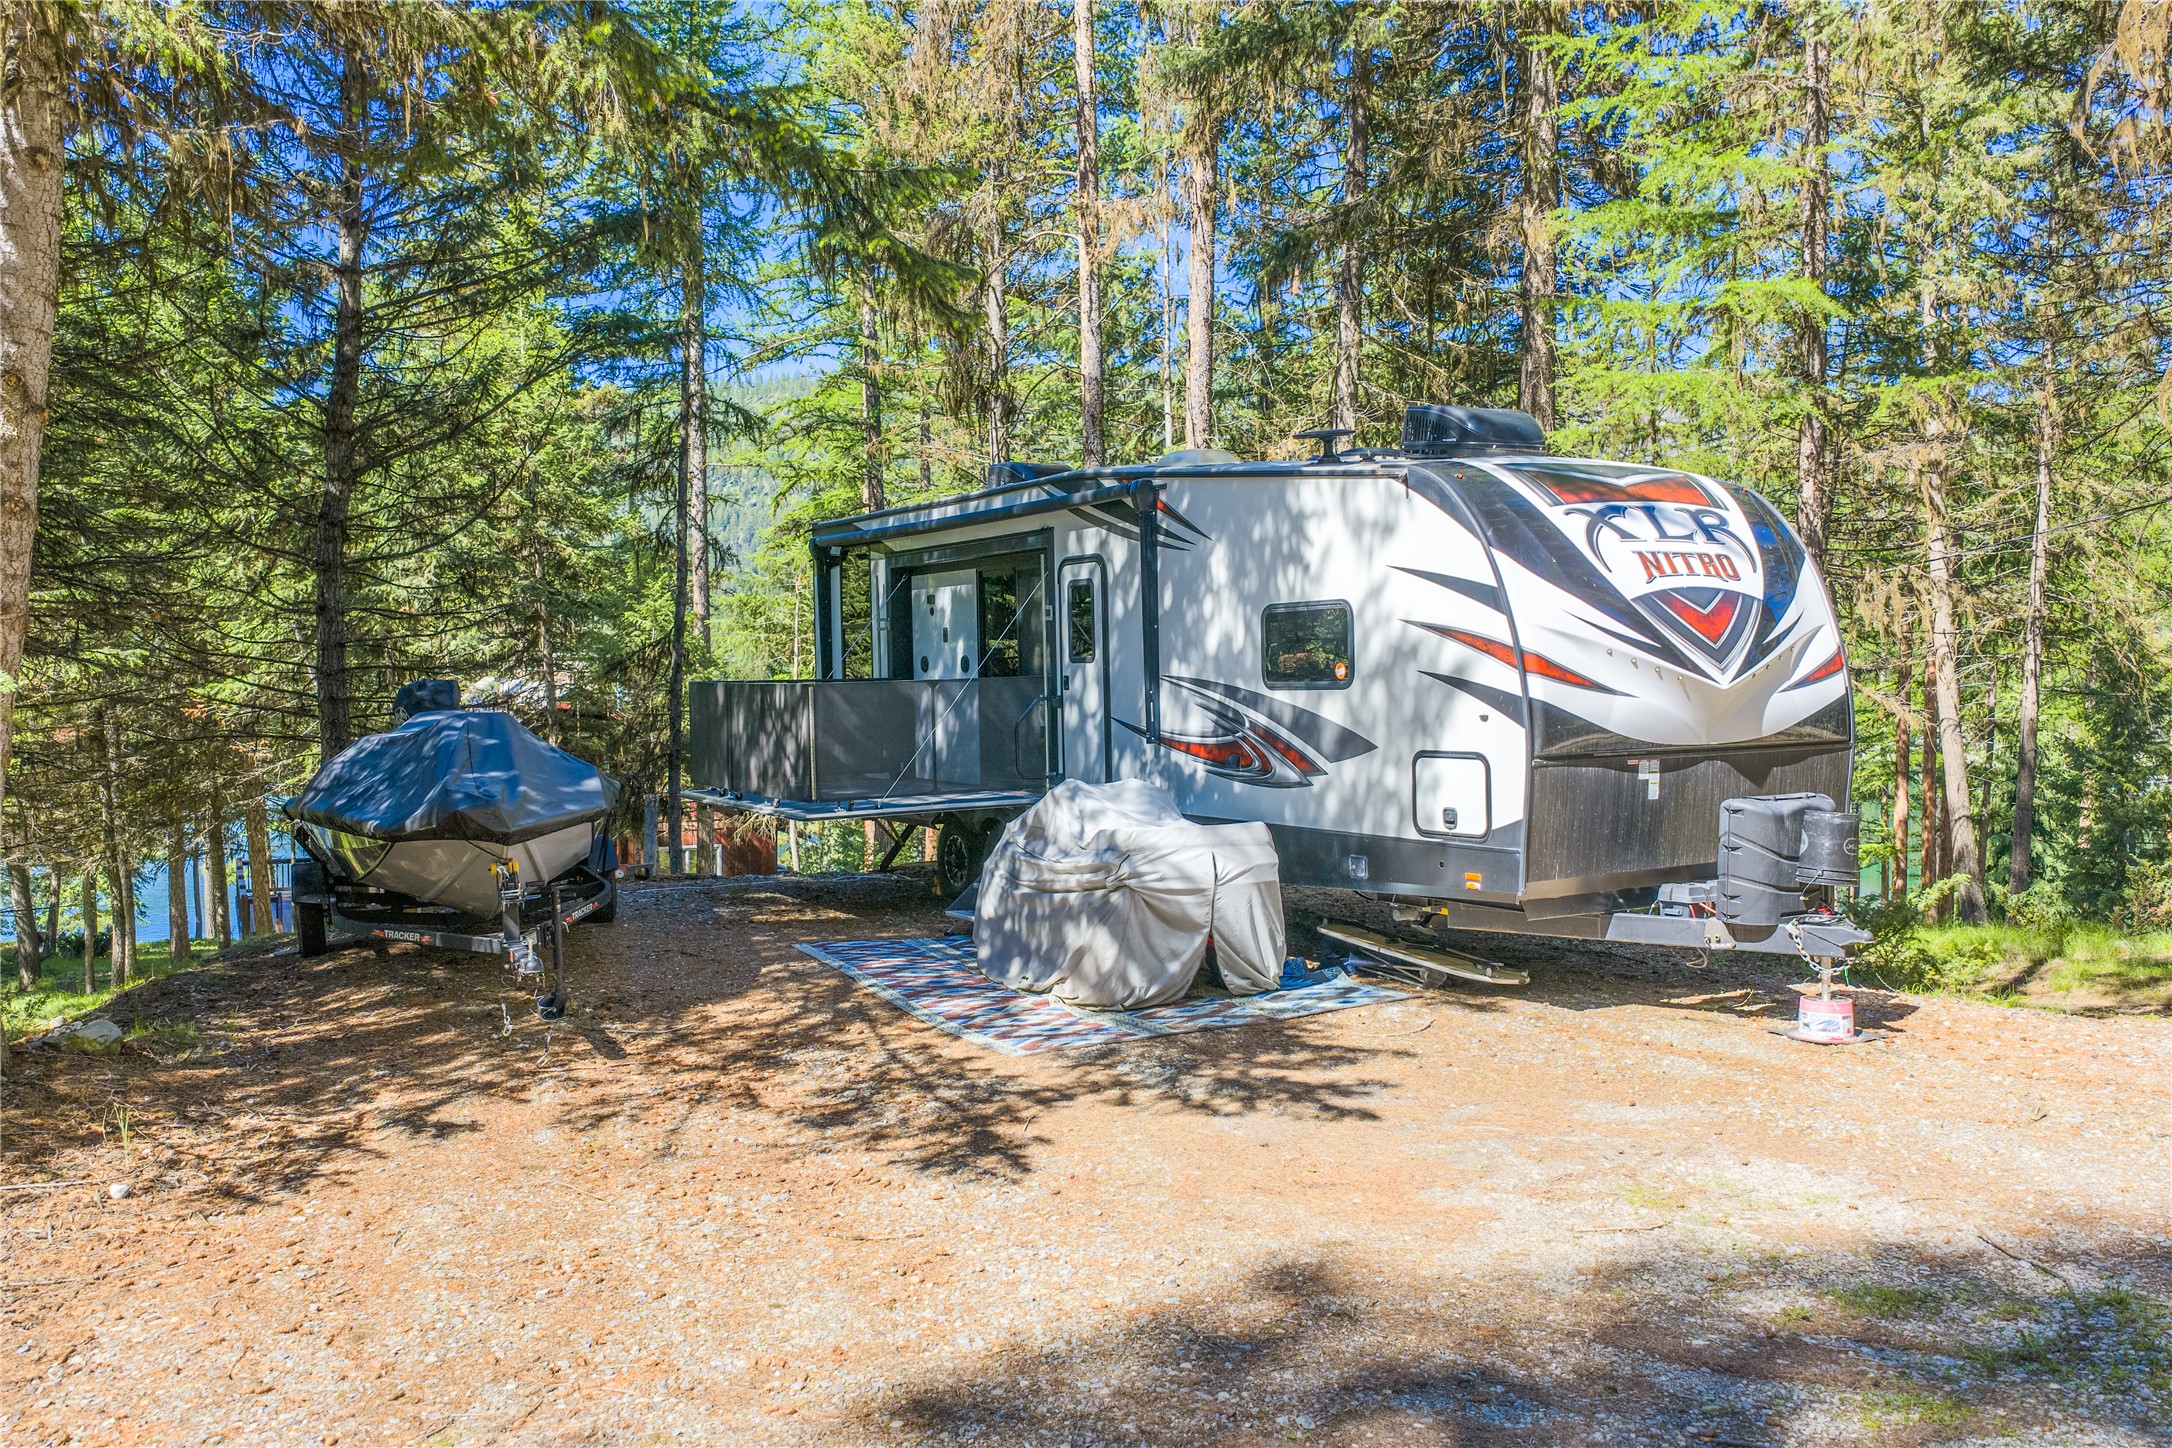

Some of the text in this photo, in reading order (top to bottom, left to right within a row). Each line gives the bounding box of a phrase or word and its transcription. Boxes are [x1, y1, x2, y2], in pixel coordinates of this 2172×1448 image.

[1563, 504, 1757, 574] XLR
[1632, 550, 1742, 584] NITRO
[571, 903, 593, 921] TRACKER
[384, 929, 420, 942] TRACKER
